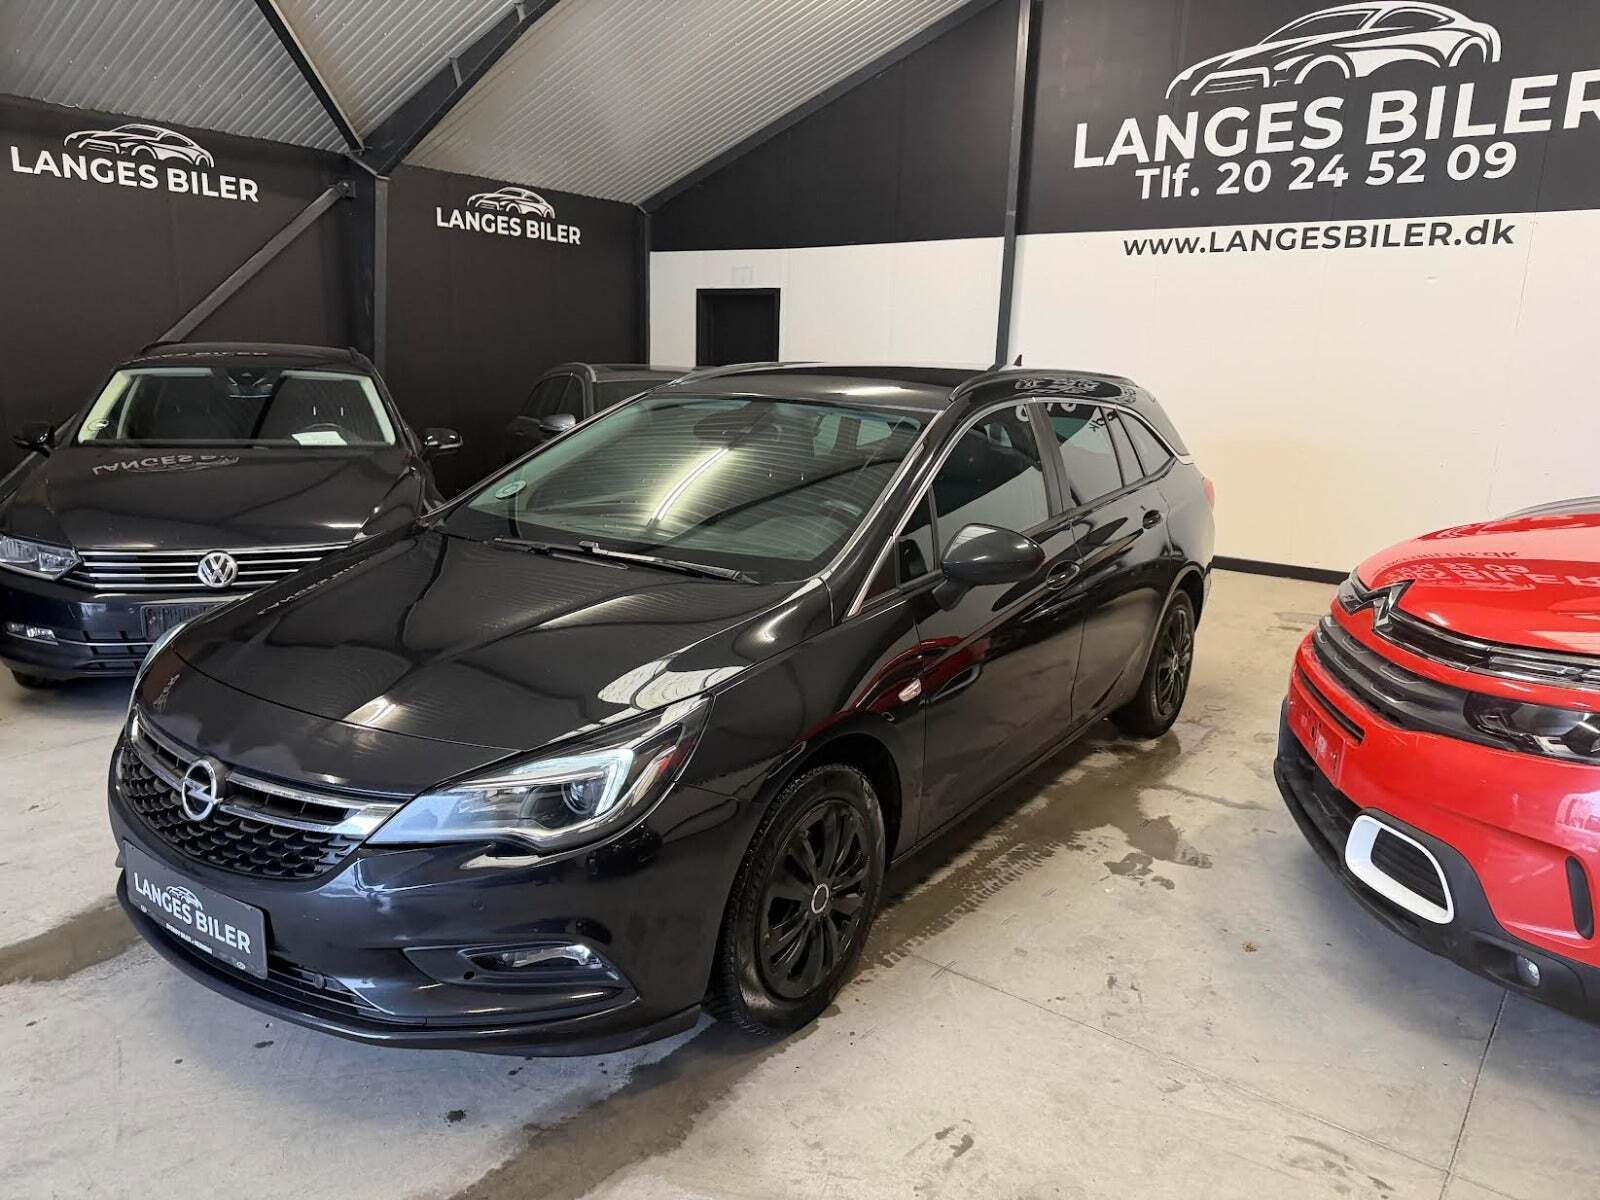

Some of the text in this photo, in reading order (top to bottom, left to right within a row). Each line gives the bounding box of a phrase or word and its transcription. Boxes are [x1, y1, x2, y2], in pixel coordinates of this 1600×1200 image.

[1073, 69, 1600, 168] LANGES BILER
[10, 145, 259, 202] LANGES BILER
[1134, 140, 1517, 200] Tlf. 20 24 52 09
[436, 206, 581, 245] LANGES BILER
[1123, 218, 1516, 256] www.LANGESBILER.dk
[133, 872, 193, 925] LANGES
[195, 909, 252, 954] BILER
